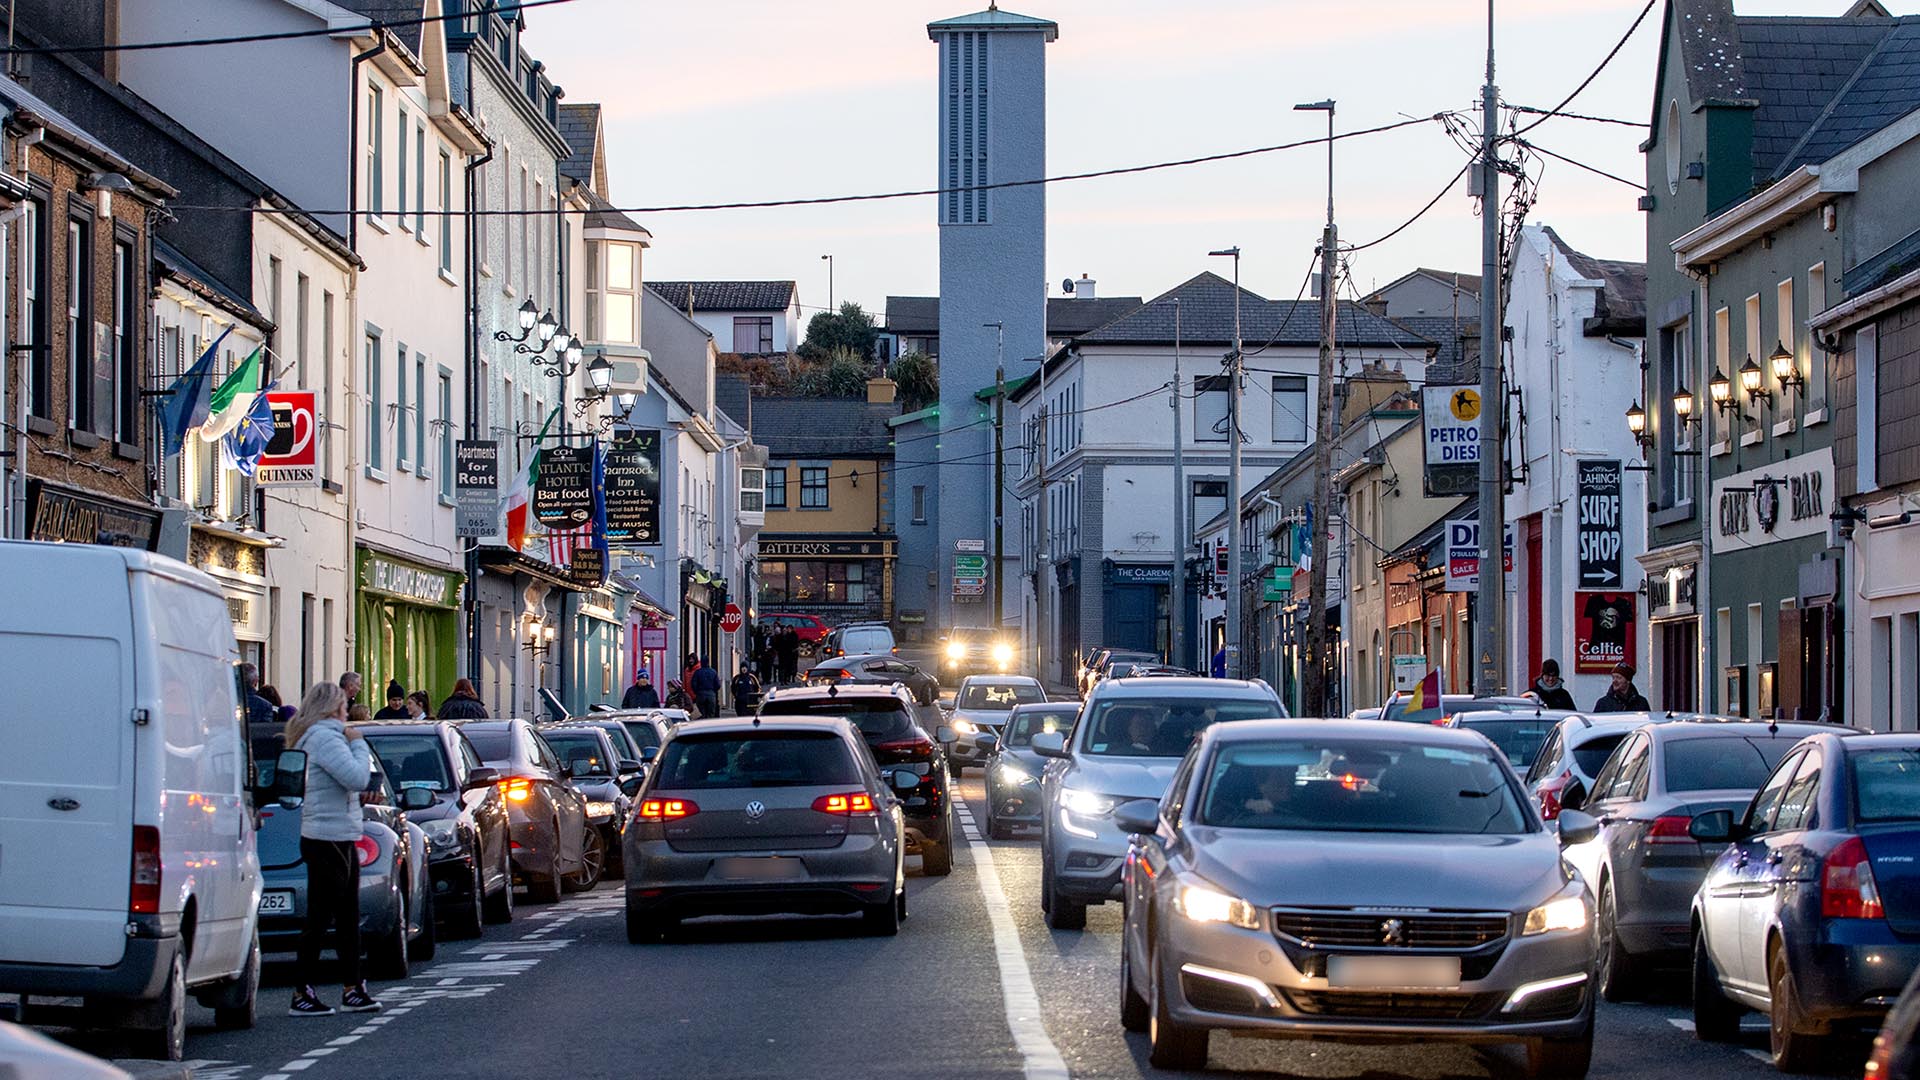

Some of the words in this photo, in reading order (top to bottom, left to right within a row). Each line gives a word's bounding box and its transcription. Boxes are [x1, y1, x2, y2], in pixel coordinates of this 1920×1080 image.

[1430, 427, 1480, 442] PETRO
[457, 443, 496, 463] Apartments
[614, 455, 637, 463] THE
[468, 462, 488, 471] for
[259, 469, 314, 482] GUINNESS
[458, 472, 495, 485] Rent
[545, 476, 582, 487] HOTEL
[1579, 473, 1620, 485] LAHINCH
[537, 490, 559, 500] Bar
[561, 488, 589, 499] food
[1789, 470, 1823, 521] BAR
[1580, 495, 1620, 528] SURF
[758, 543, 831, 554] LATTERY'S
[1580, 531, 1621, 564] SHOP
[1453, 564, 1475, 575] SALE
[1579, 642, 1624, 655] Celtic
